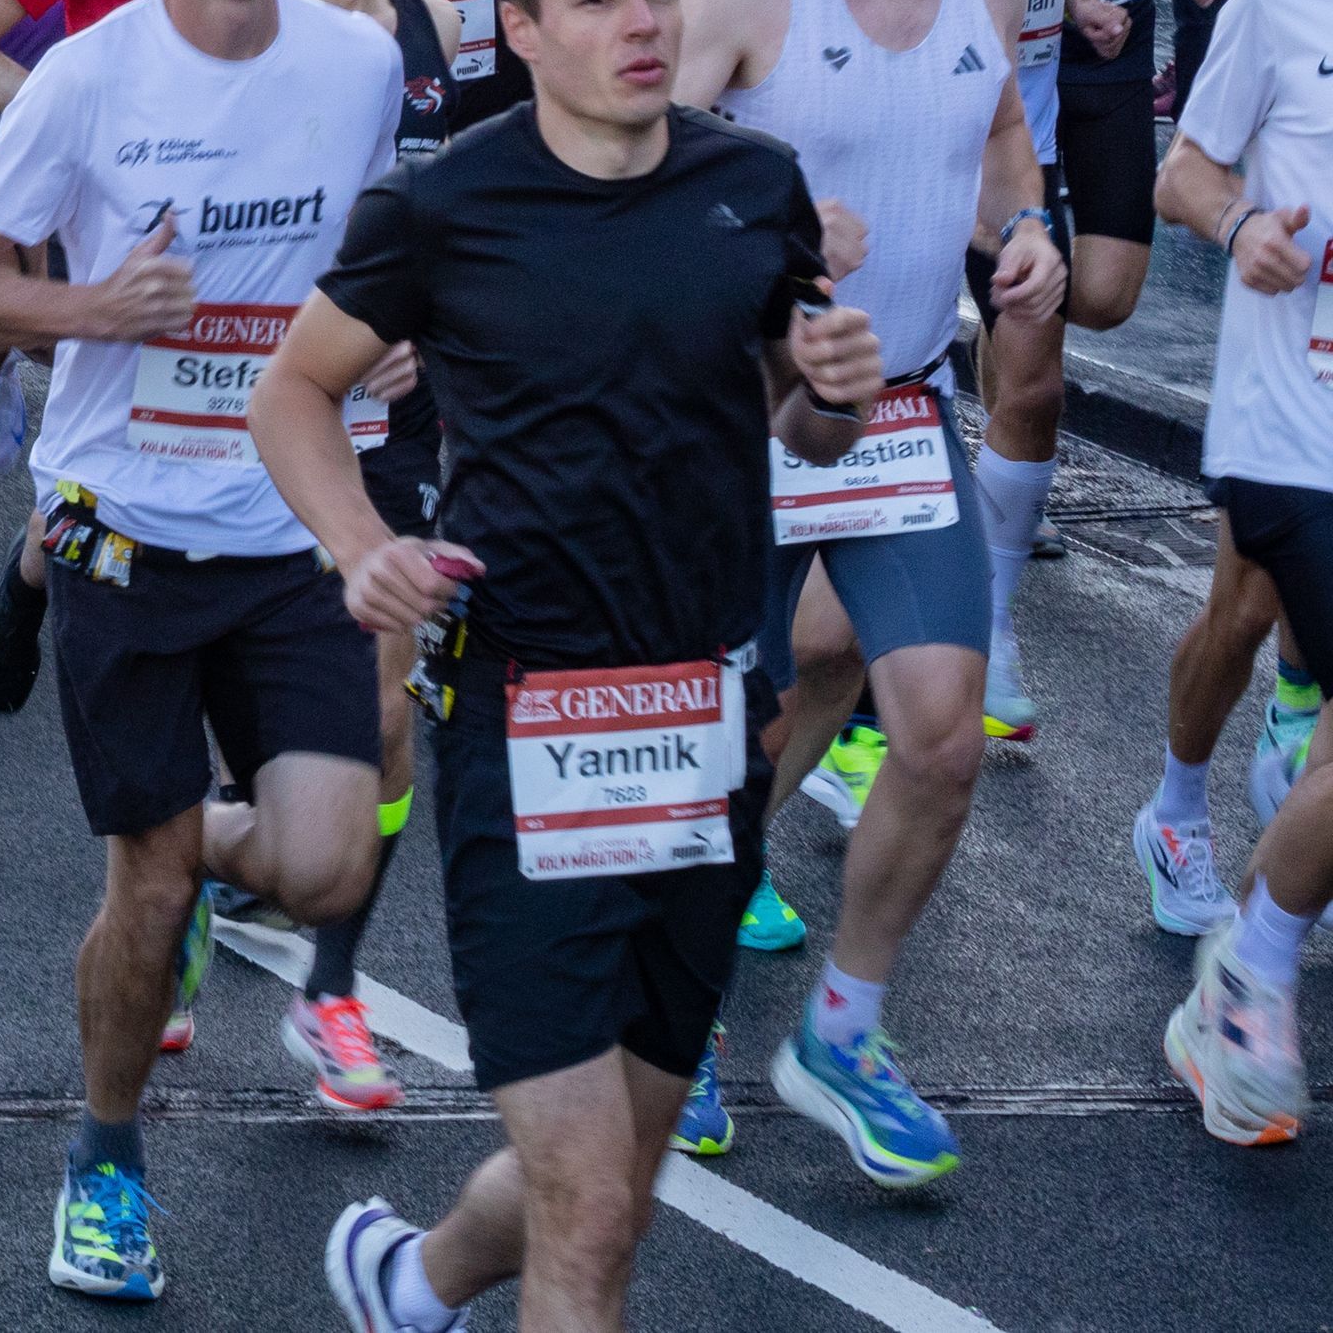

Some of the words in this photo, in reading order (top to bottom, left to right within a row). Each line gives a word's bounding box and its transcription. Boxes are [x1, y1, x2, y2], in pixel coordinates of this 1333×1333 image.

[456, 65, 479, 76] PUMA
[199, 185, 328, 234] bunert
[193, 315, 288, 346] GENER
[782, 437, 936, 469] Sastian
[560, 677, 720, 720] GENERALI
[543, 733, 702, 780] Yannik
[571, 850, 639, 869] MARATHON
